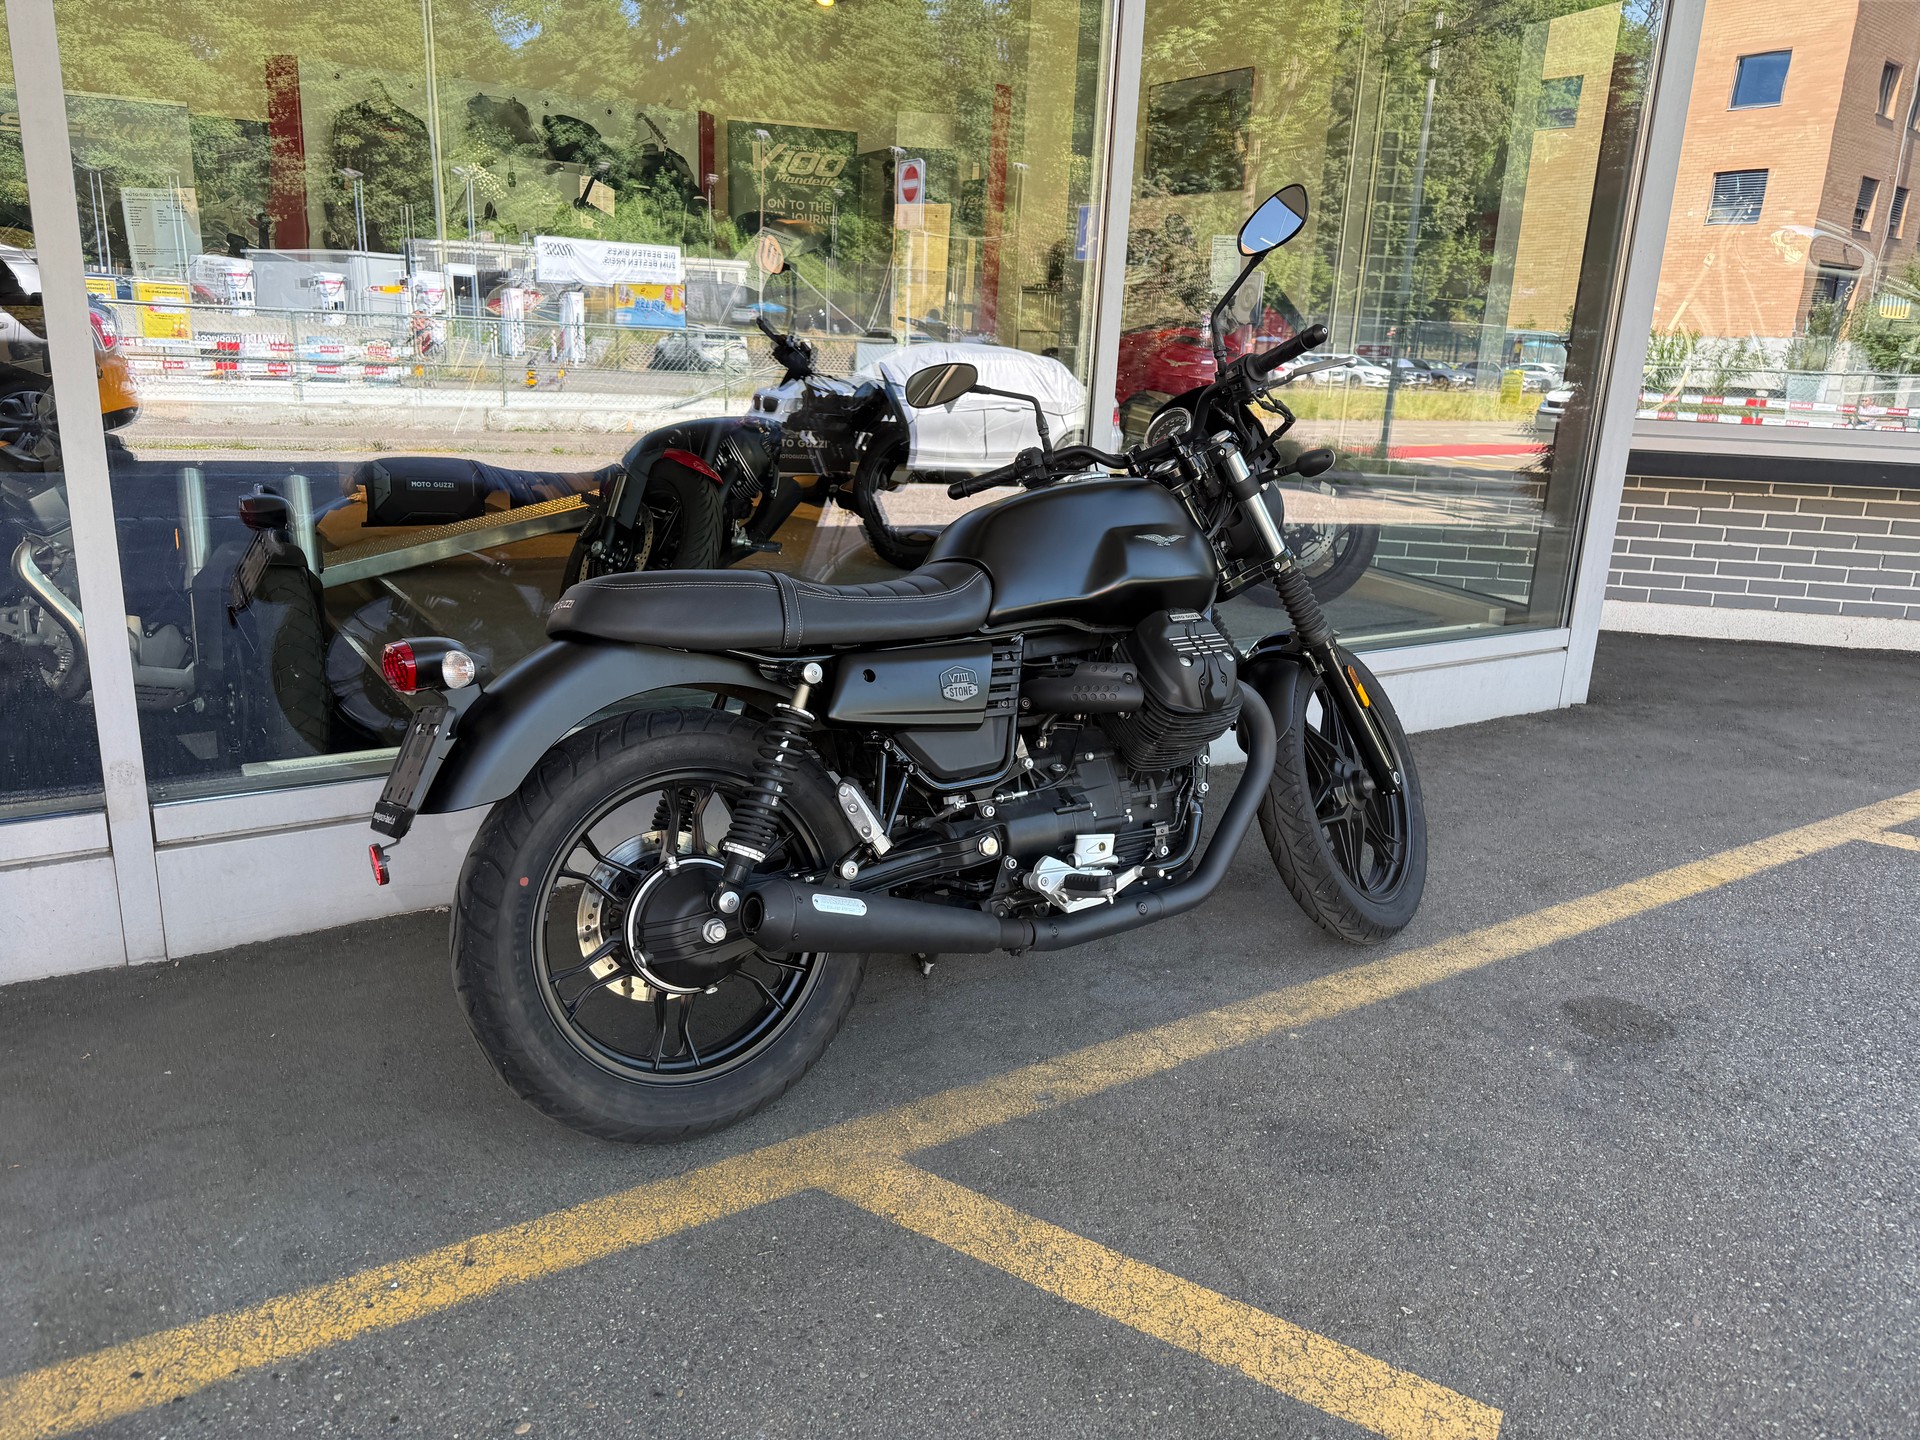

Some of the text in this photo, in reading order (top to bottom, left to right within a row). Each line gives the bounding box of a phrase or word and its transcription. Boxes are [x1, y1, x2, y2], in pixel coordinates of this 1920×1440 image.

[752, 141, 847, 178] V100
[774, 173, 839, 187] Mandello
[767, 198, 832, 212] ON TO THE
[781, 438, 828, 449] TO GUZZI
[949, 685, 974, 698] STONE
